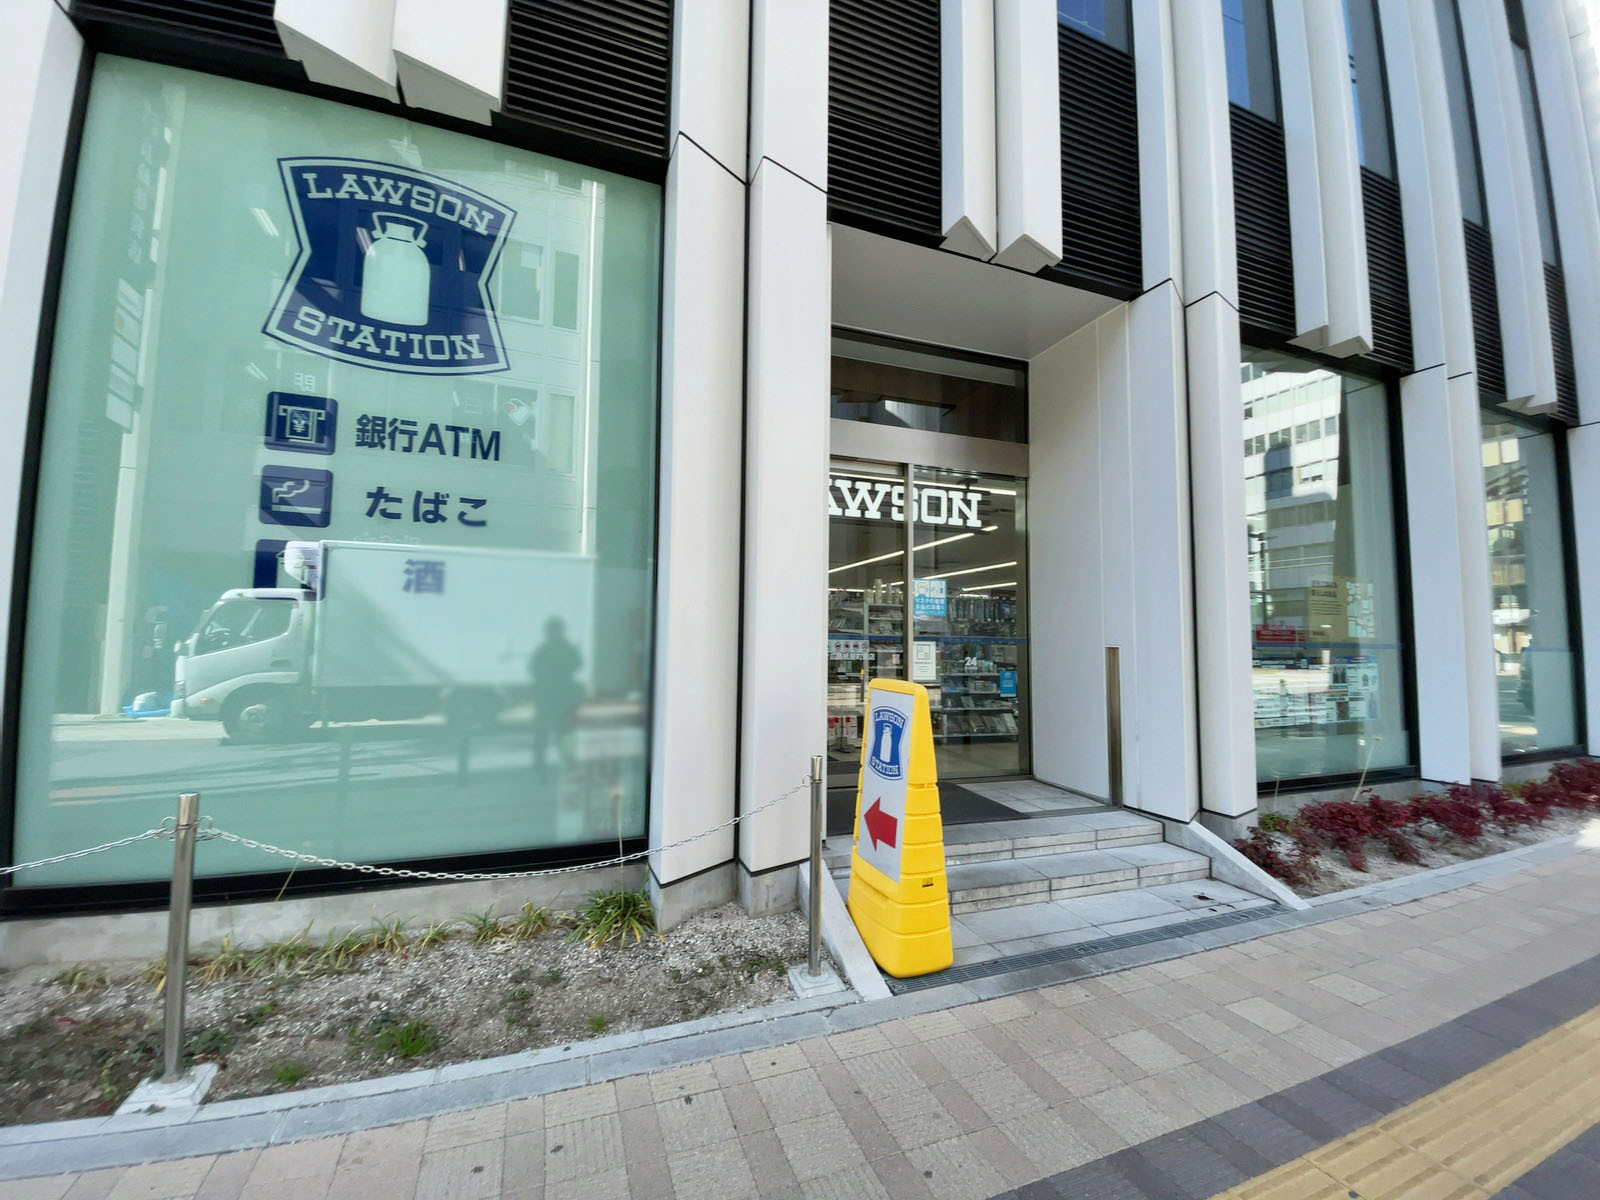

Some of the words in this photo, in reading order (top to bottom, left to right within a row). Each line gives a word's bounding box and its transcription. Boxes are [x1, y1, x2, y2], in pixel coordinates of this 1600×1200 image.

[302, 172, 494, 235] LAWSON
[293, 305, 485, 360] STATION
[354, 413, 501, 462] 銀行ATM
[365, 486, 488, 527] たばこ
[402, 558, 446, 596] 酒
[871, 756, 899, 774] STATION
